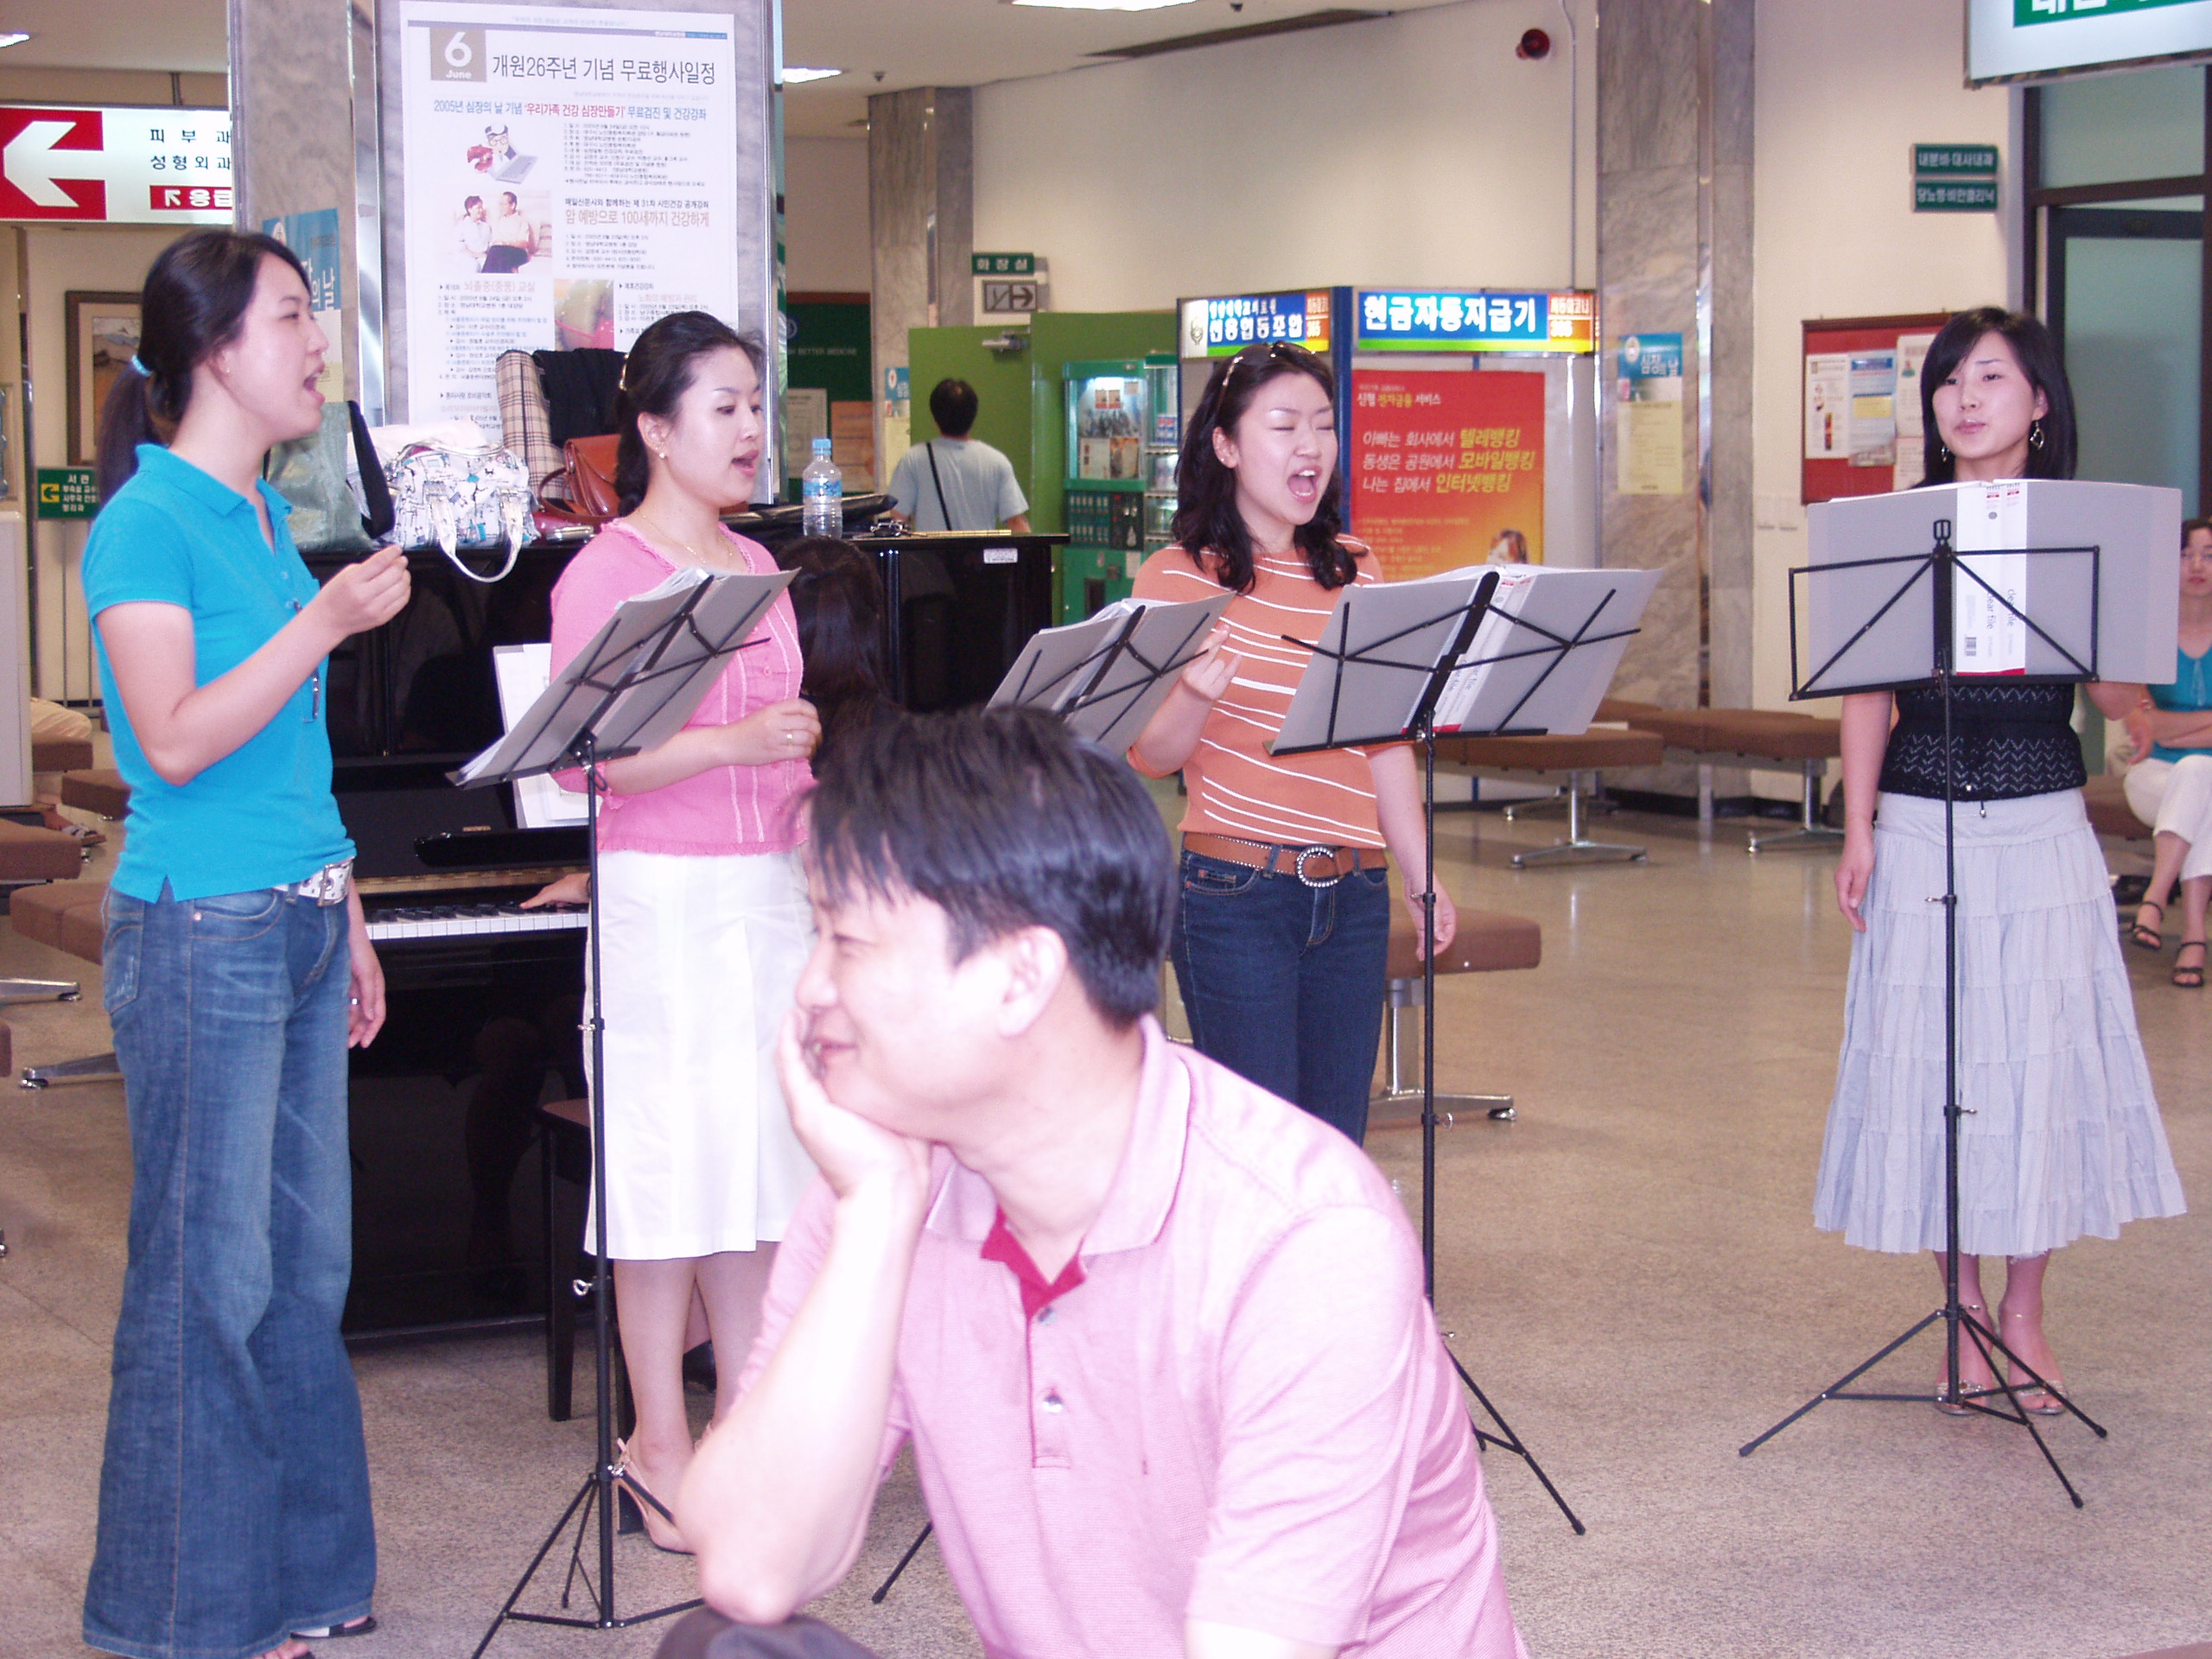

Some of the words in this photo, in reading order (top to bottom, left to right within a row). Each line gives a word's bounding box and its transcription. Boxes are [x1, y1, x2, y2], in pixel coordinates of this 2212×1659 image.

[444, 31, 473, 67] 6
[446, 70, 472, 79] June
[493, 54, 576, 79] 개원26주년
[583, 58, 614, 81] 기념
[620, 60, 715, 86] 무료행사일정
[434, 99, 463, 113] 2005년
[467, 101, 492, 114] 심장의
[494, 101, 503, 115] 날
[505, 102, 523, 115] 기념
[563, 104, 579, 118] 건강
[627, 106, 661, 119] 무료검진
[565, 209, 575, 225] 암
[578, 209, 619, 226] 예방으로
[671, 211, 709, 227] 건강하게
[1364, 295, 1536, 333] 현금자동지급기
[1414, 393, 1441, 406] 서비스
[1363, 430, 1401, 448] 아빠는
[1405, 430, 1456, 448] 회사에서
[1460, 428, 1521, 448] 텔레뱅킹
[1363, 454, 1401, 470] 동생은
[1405, 454, 1456, 470] 공원에서
[1459, 450, 1536, 471] 모바일뱅킹
[1363, 476, 1389, 493] 나는
[1394, 476, 1431, 493] 집에서
[1436, 473, 1511, 493] 인터넷뱅킹
